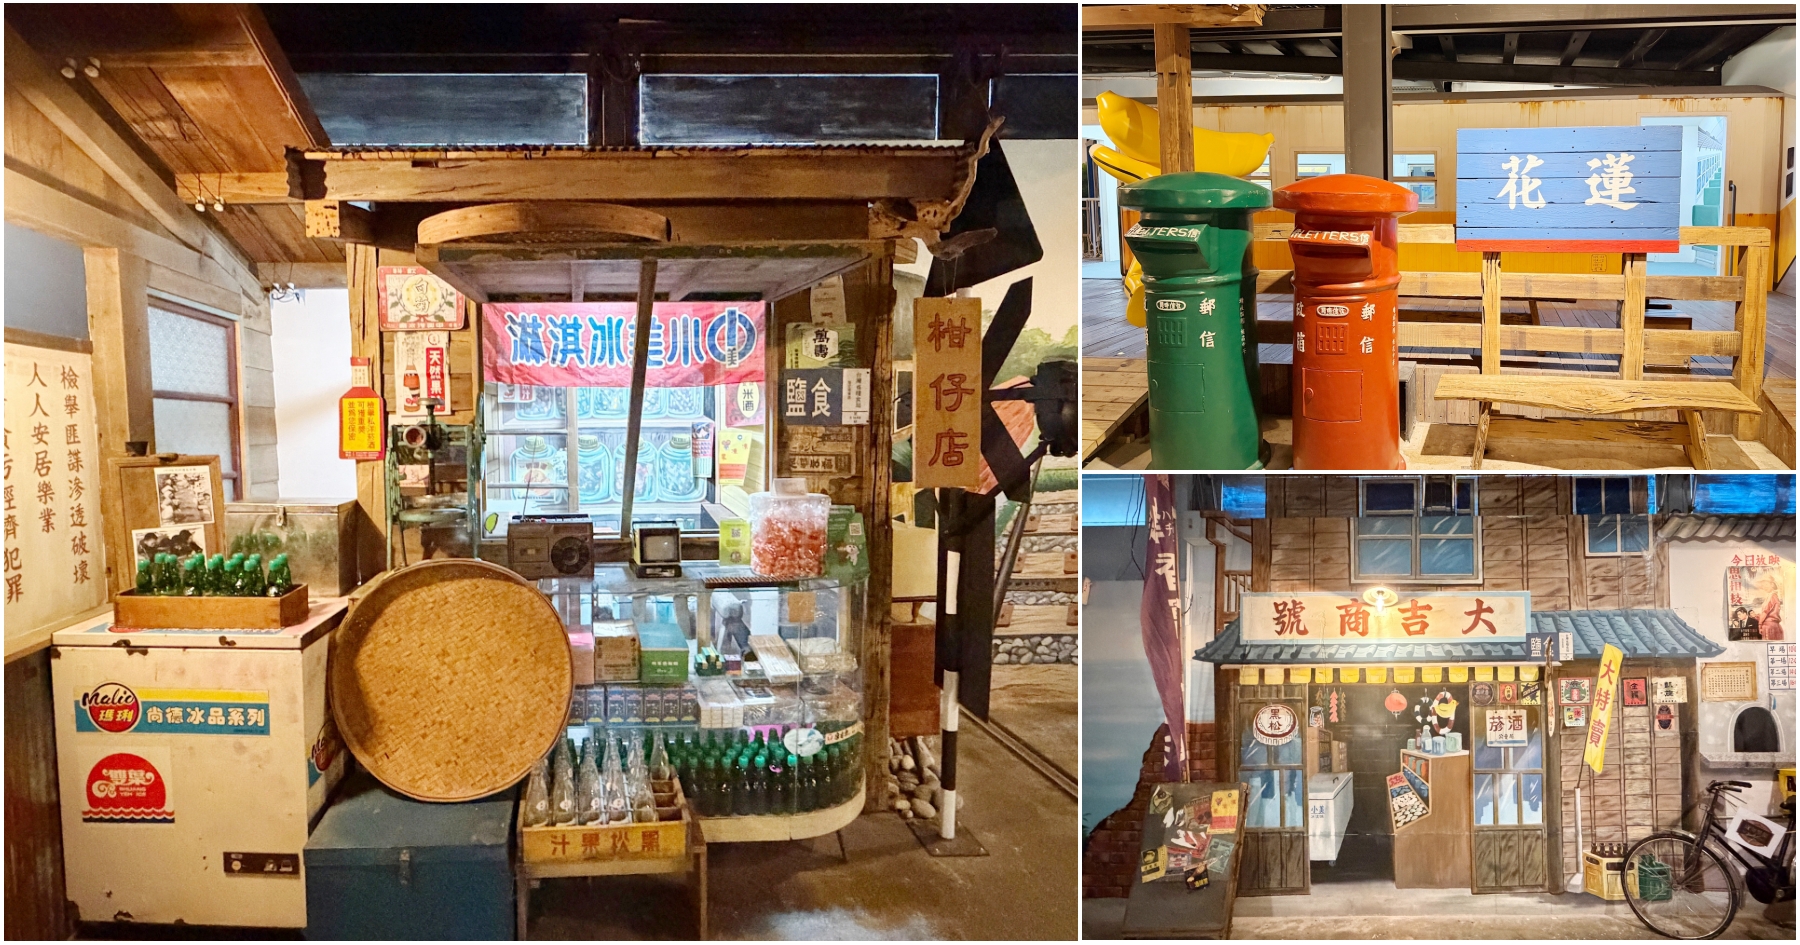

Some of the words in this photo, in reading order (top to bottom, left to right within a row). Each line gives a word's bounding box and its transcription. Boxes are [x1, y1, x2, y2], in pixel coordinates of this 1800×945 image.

[1496, 153, 1640, 211] 花蓮
[1297, 230, 1359, 241] LETTERS
[428, 349, 443, 409] 天然果
[742, 388, 755, 411] 米酒
[928, 312, 975, 468] 柑仔店
[27, 361, 56, 534] 人人安居樂業
[61, 364, 91, 585] 檢舉匪諜滲透破壞
[1730, 554, 1781, 566] 今日放映
[146, 706, 265, 727] 尚德冰品系列
[1268, 708, 1283, 731] 黑松
[1590, 659, 1616, 748] 大特賣
